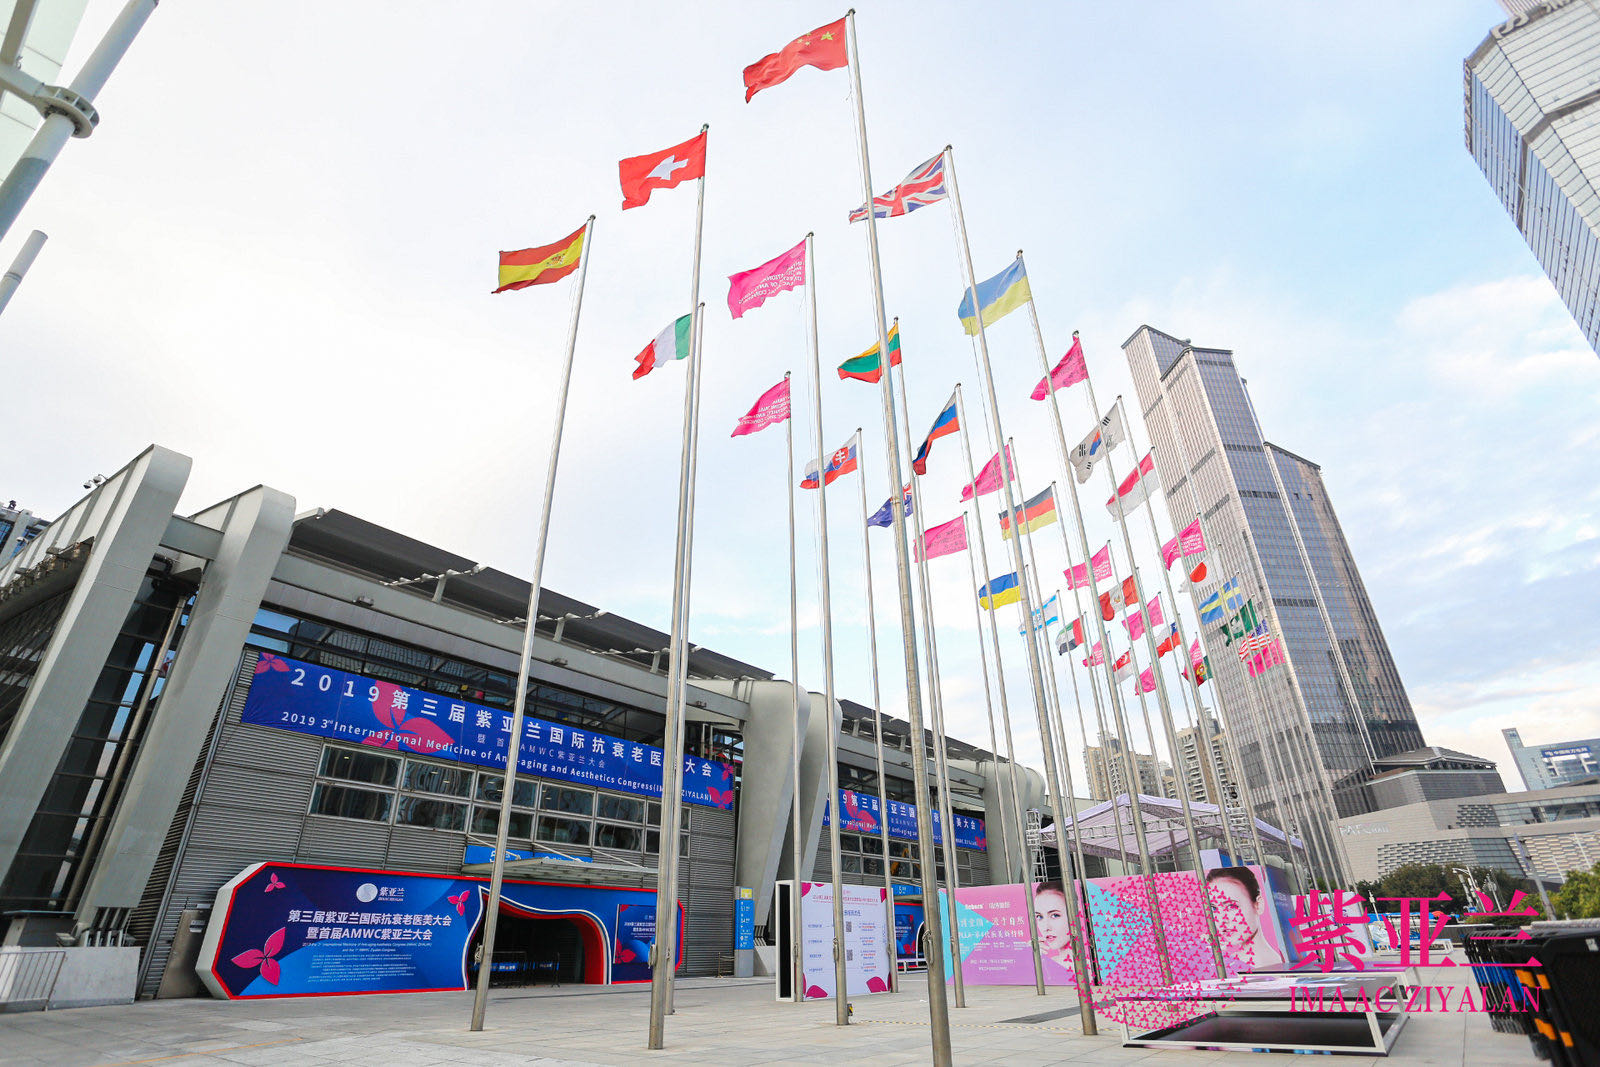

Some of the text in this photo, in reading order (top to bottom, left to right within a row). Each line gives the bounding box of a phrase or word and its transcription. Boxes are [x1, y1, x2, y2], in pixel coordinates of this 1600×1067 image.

[291, 668, 712, 777] 2019第三届紫亚兰国际抗衰老医大会
[281, 711, 316, 726] 2019
[334, 721, 422, 746] International
[426, 739, 477, 757] Medicine
[480, 751, 492, 760] of
[494, 753, 548, 772] An-aging
[551, 763, 568, 774] and
[570, 768, 615, 783] Aesthetics
[476, 733, 605, 769] 暨首AMWC紫亚兰大会
[379, 886, 405, 897] 紫亚兰
[288, 909, 452, 927] 第三届紫亚兰国际抗衰老医美大会
[306, 926, 433, 941] 暨首届AMWC紫亚兰大会
